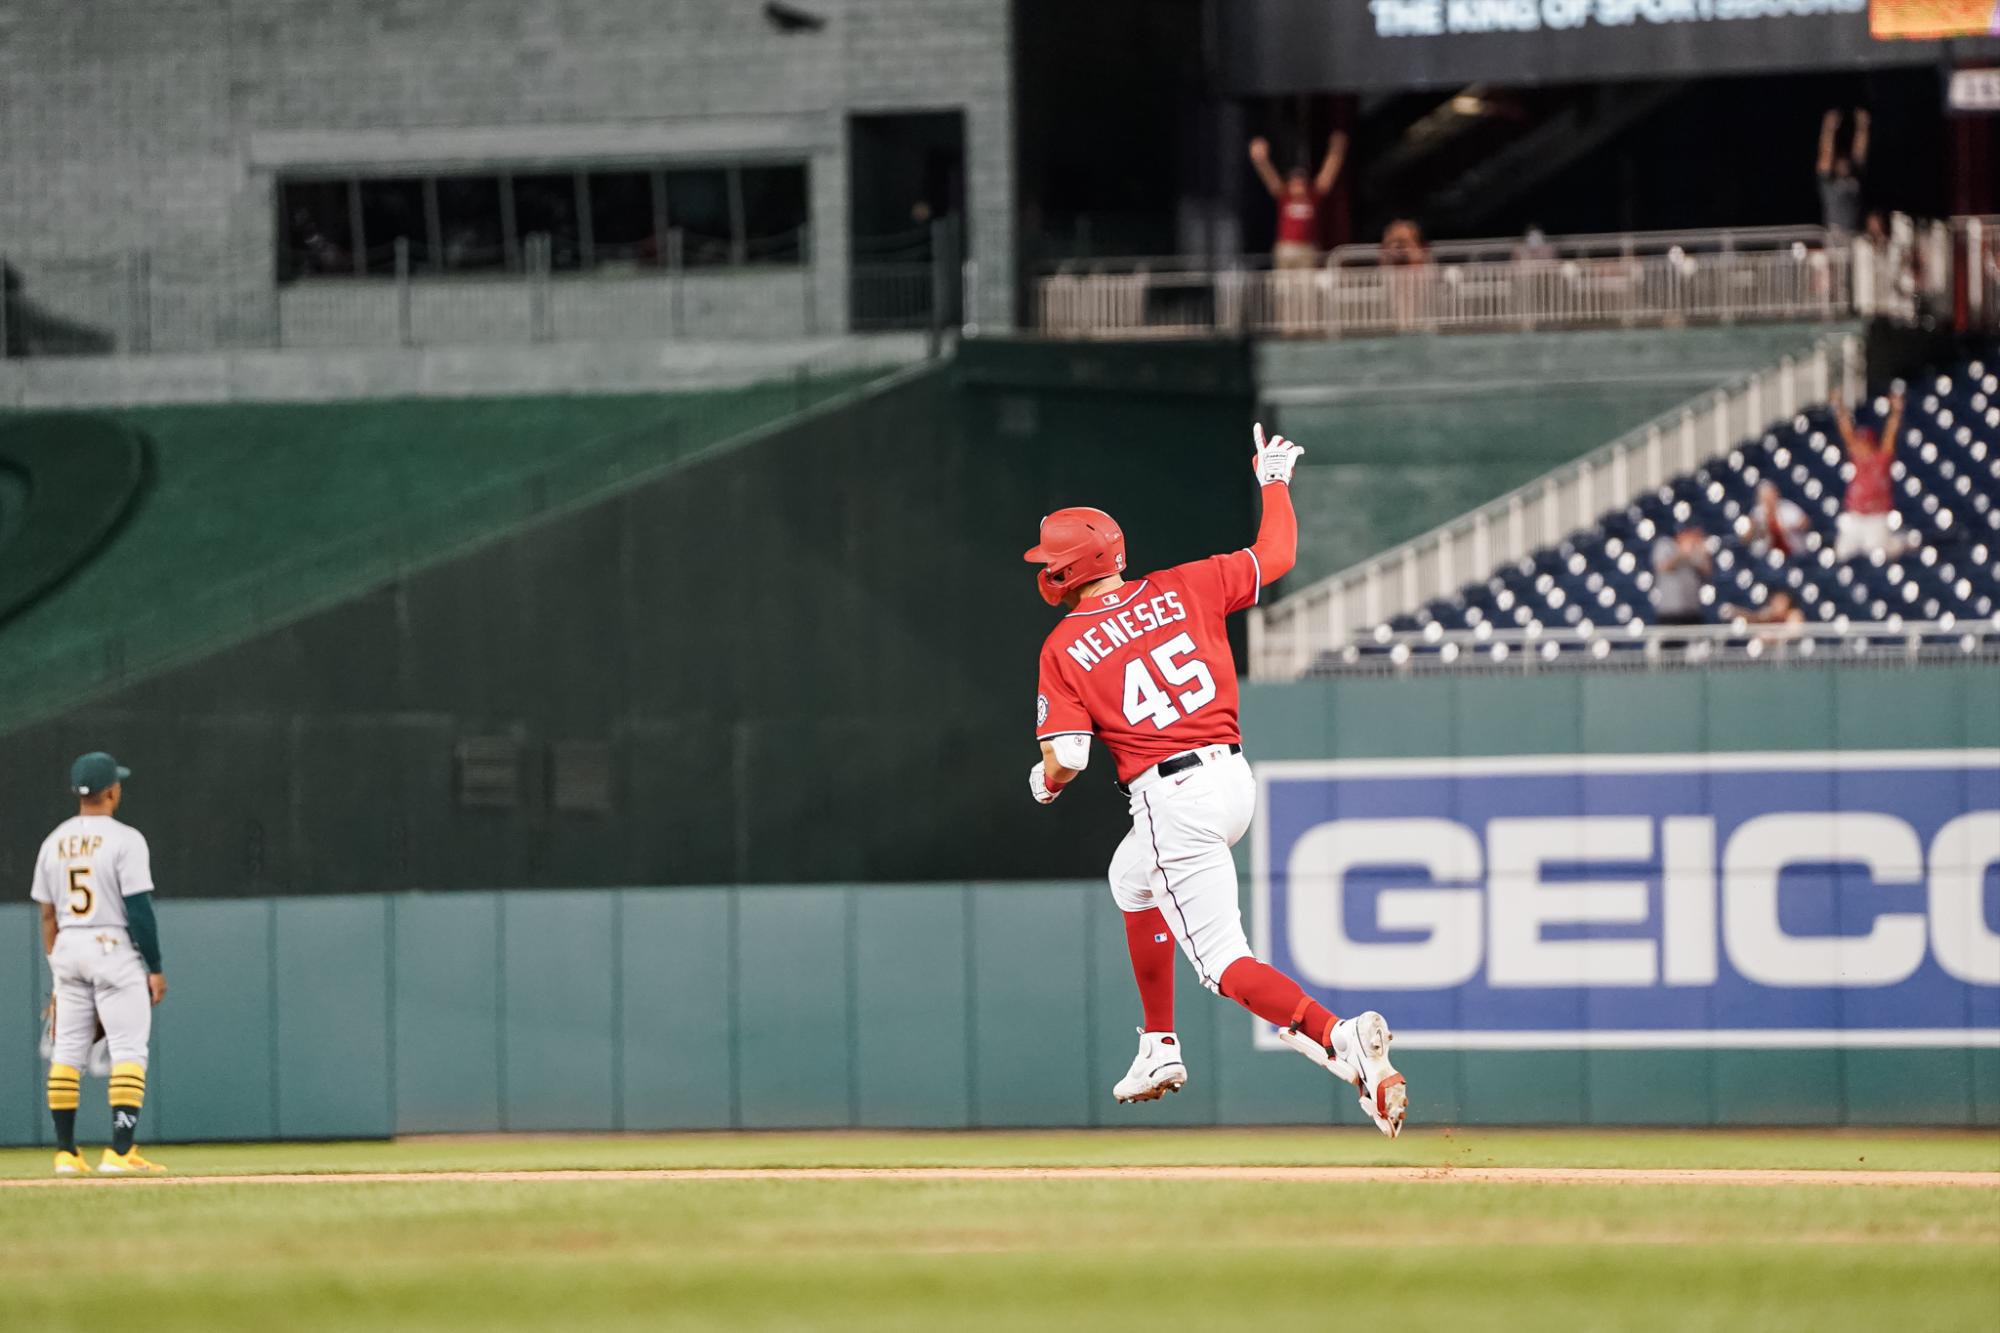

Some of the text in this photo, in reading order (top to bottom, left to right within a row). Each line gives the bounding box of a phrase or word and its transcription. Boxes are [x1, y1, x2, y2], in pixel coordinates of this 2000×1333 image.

[1369, 0, 1445, 37] THE
[1448, 0, 1541, 33] KING
[1542, 0, 1587, 29] OF
[1067, 591, 1186, 672] MENESES
[1122, 631, 1216, 730] 45
[58, 835, 103, 859] KEMP
[68, 866, 94, 917] 5
